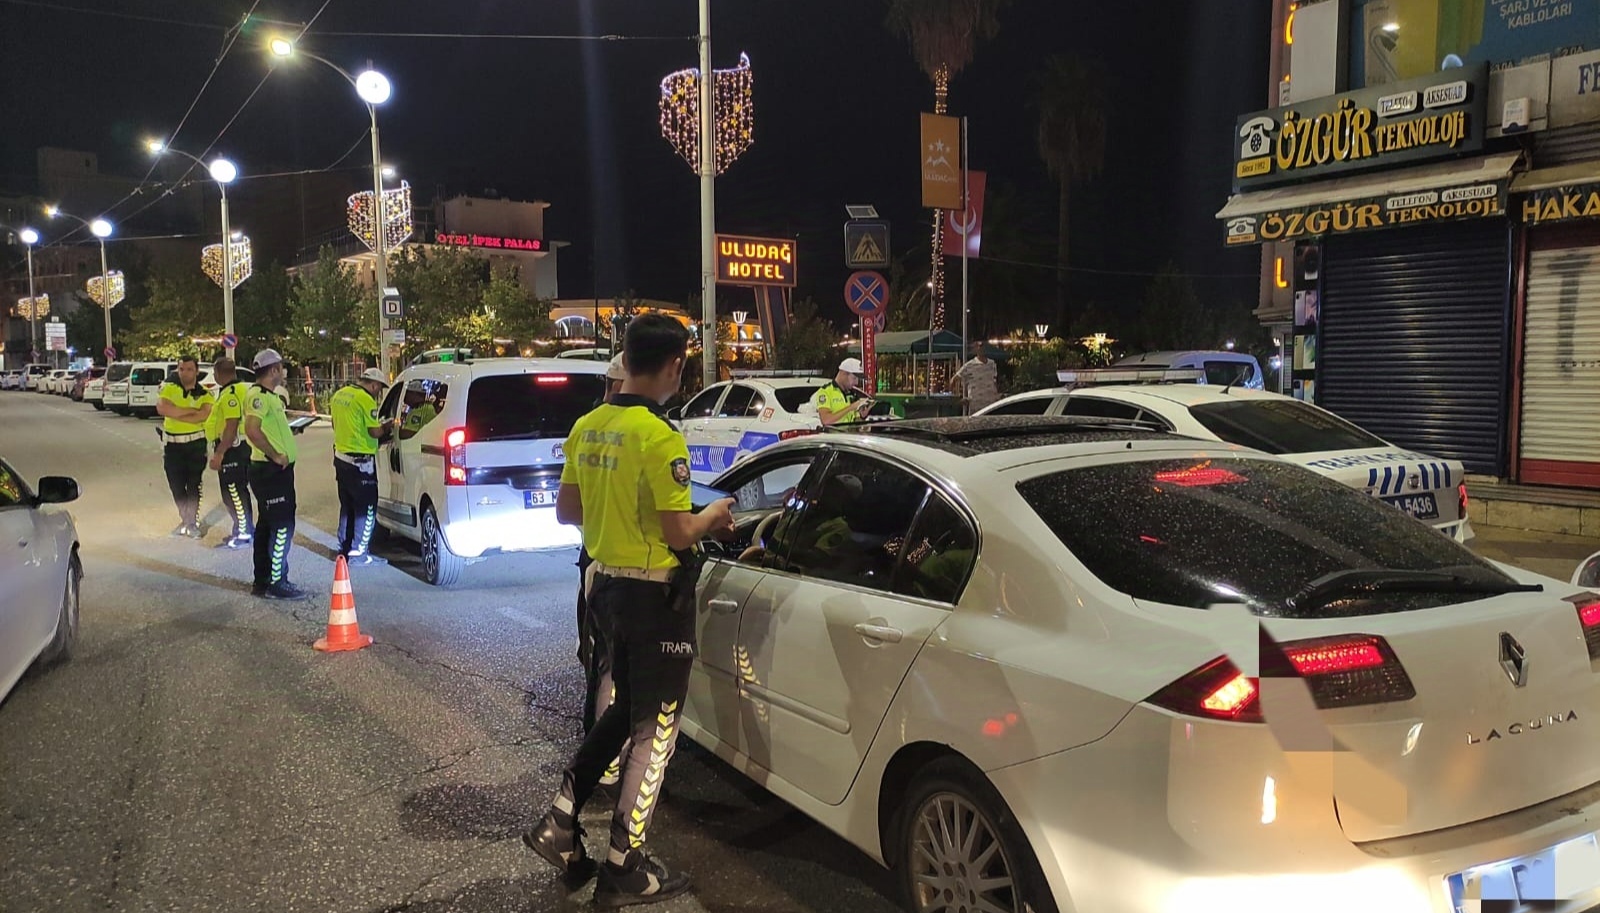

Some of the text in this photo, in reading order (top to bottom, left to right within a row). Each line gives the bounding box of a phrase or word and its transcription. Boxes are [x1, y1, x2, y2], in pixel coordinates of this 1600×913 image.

[1508, 2, 1572, 30] KABLOLARI
[1277, 98, 1372, 169] ÖZGÜR
[1391, 186, 1493, 207] TELEFON AKSESUAR
[1260, 203, 1383, 239] ÖZGÜR
[437, 233, 470, 245] OTEL
[504, 238, 540, 250] PALAS
[721, 241, 791, 264] ULUDAĞ
[729, 262, 785, 279] HOTEL
[389, 302, 398, 313] D
[532, 492, 545, 504] 63
[1405, 496, 1433, 515] 5436
[1466, 709, 1578, 746] LAGUNA
